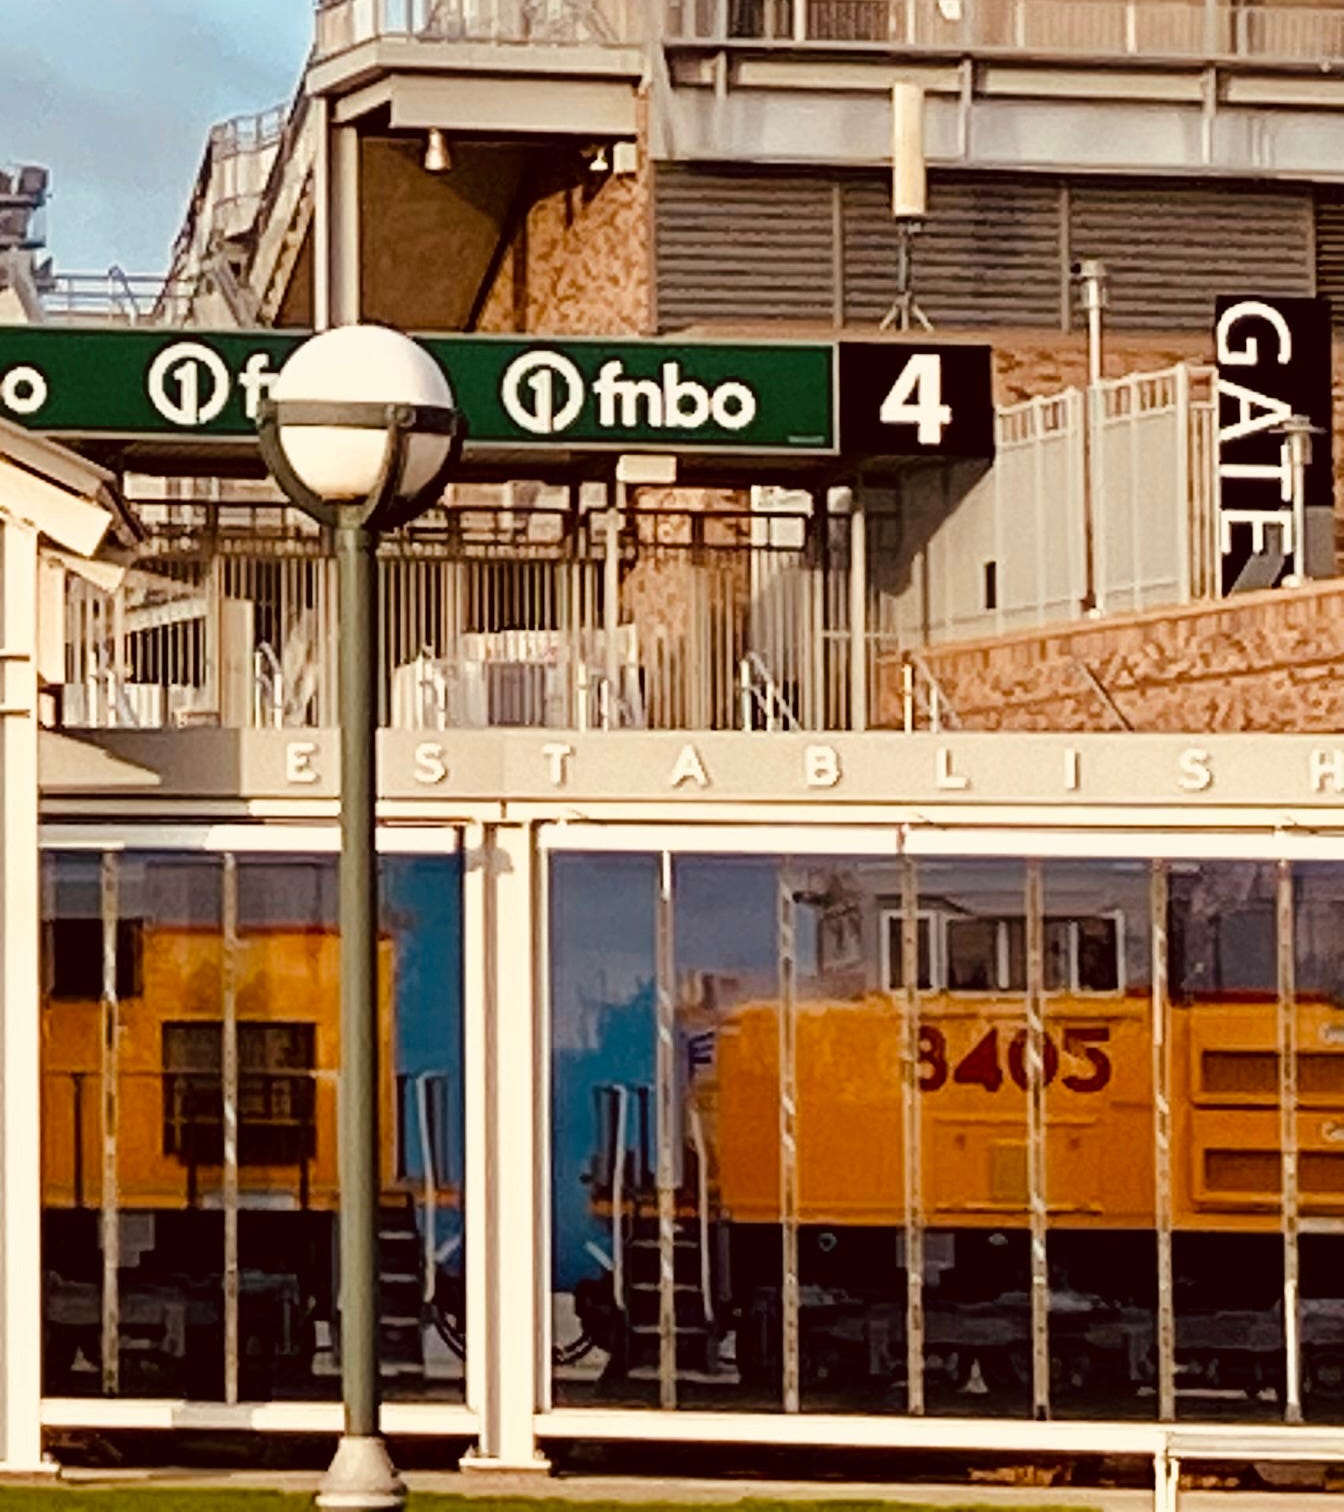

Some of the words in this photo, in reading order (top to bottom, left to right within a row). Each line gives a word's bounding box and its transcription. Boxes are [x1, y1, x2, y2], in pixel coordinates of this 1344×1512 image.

[593, 360, 756, 430] fnbo
[879, 353, 952, 444] 4
[1216, 300, 1292, 556] GATE
[285, 742, 1344, 794] ESTABLISH
